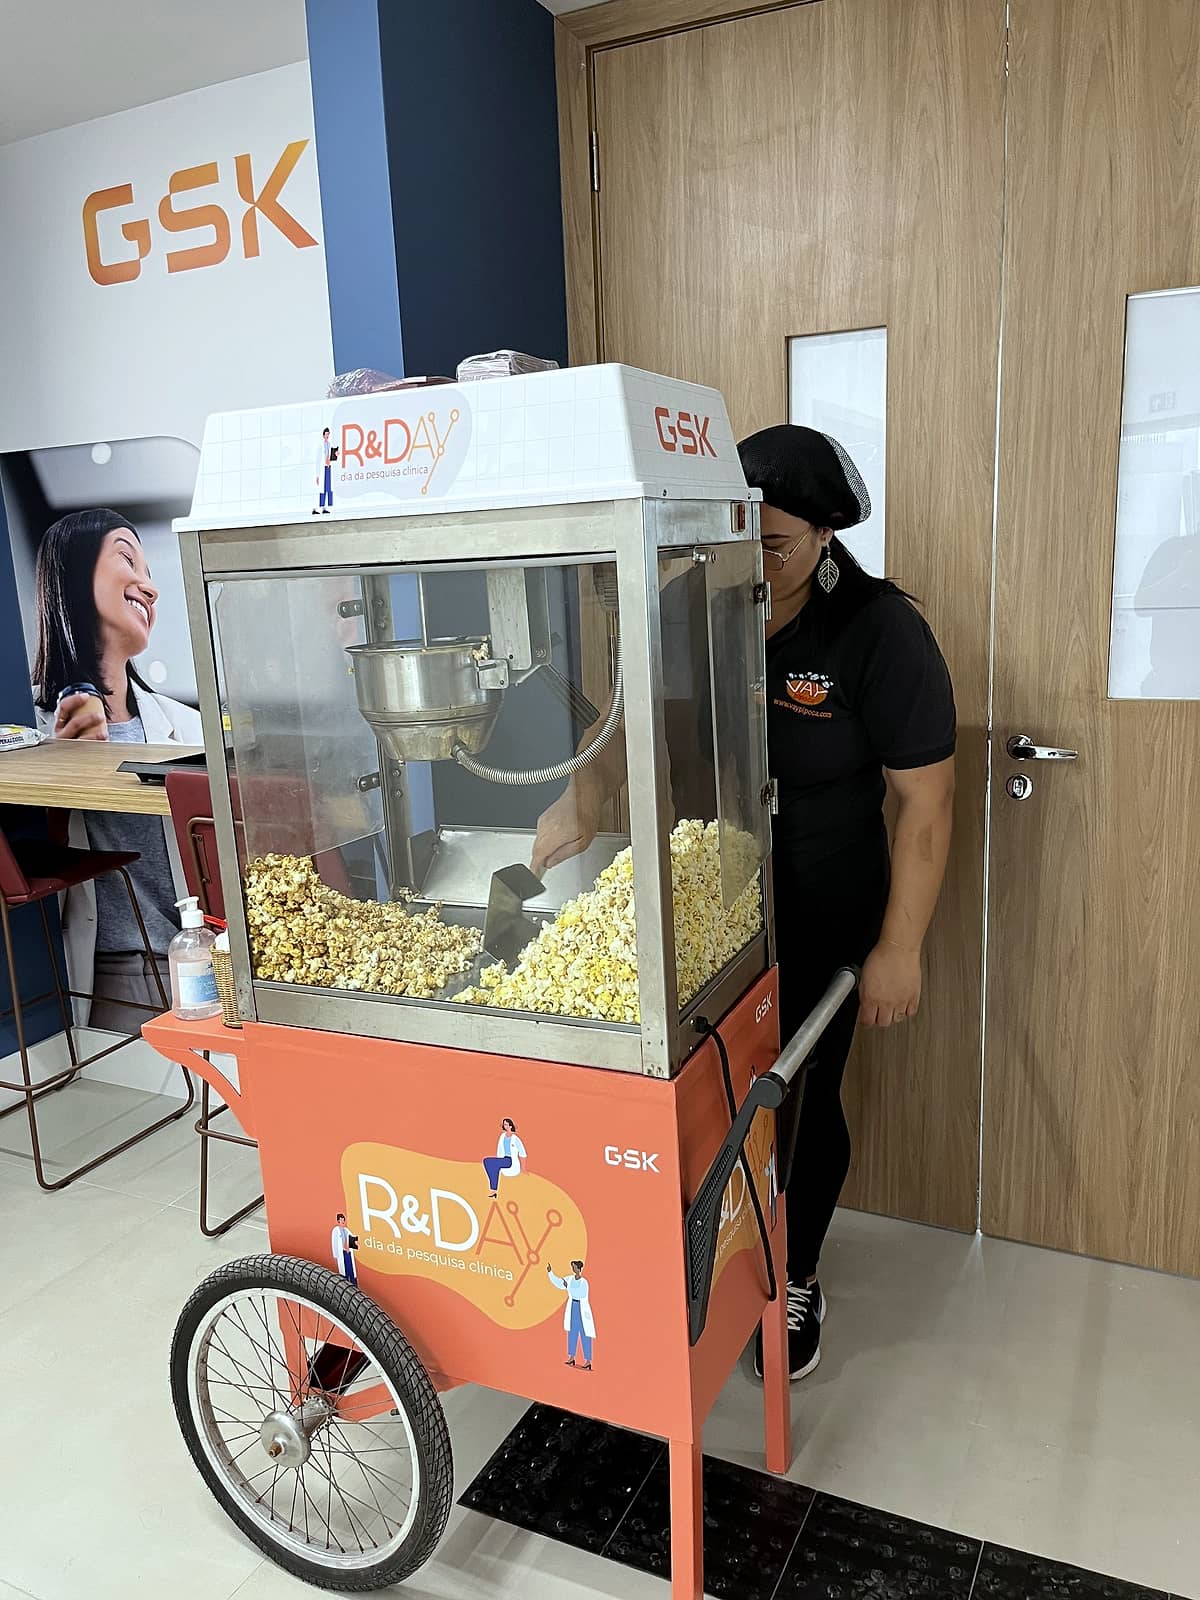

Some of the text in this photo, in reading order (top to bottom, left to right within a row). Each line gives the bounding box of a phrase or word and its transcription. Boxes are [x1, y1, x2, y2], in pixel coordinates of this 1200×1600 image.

[82, 138, 320, 286] GSK
[654, 406, 718, 458] GSK
[341, 408, 460, 495] R&DAY
[340, 471, 353, 482] dia
[354, 470, 366, 481] da
[366, 466, 401, 481] pesquisa
[786, 679, 829, 698] VAY
[755, 990, 773, 1024] GSK
[604, 1145, 661, 1173] GSK
[358, 1173, 563, 1308] R&DAY
[364, 1236, 385, 1252] dia
[386, 1241, 404, 1256] da
[406, 1247, 466, 1271] pesquisa
